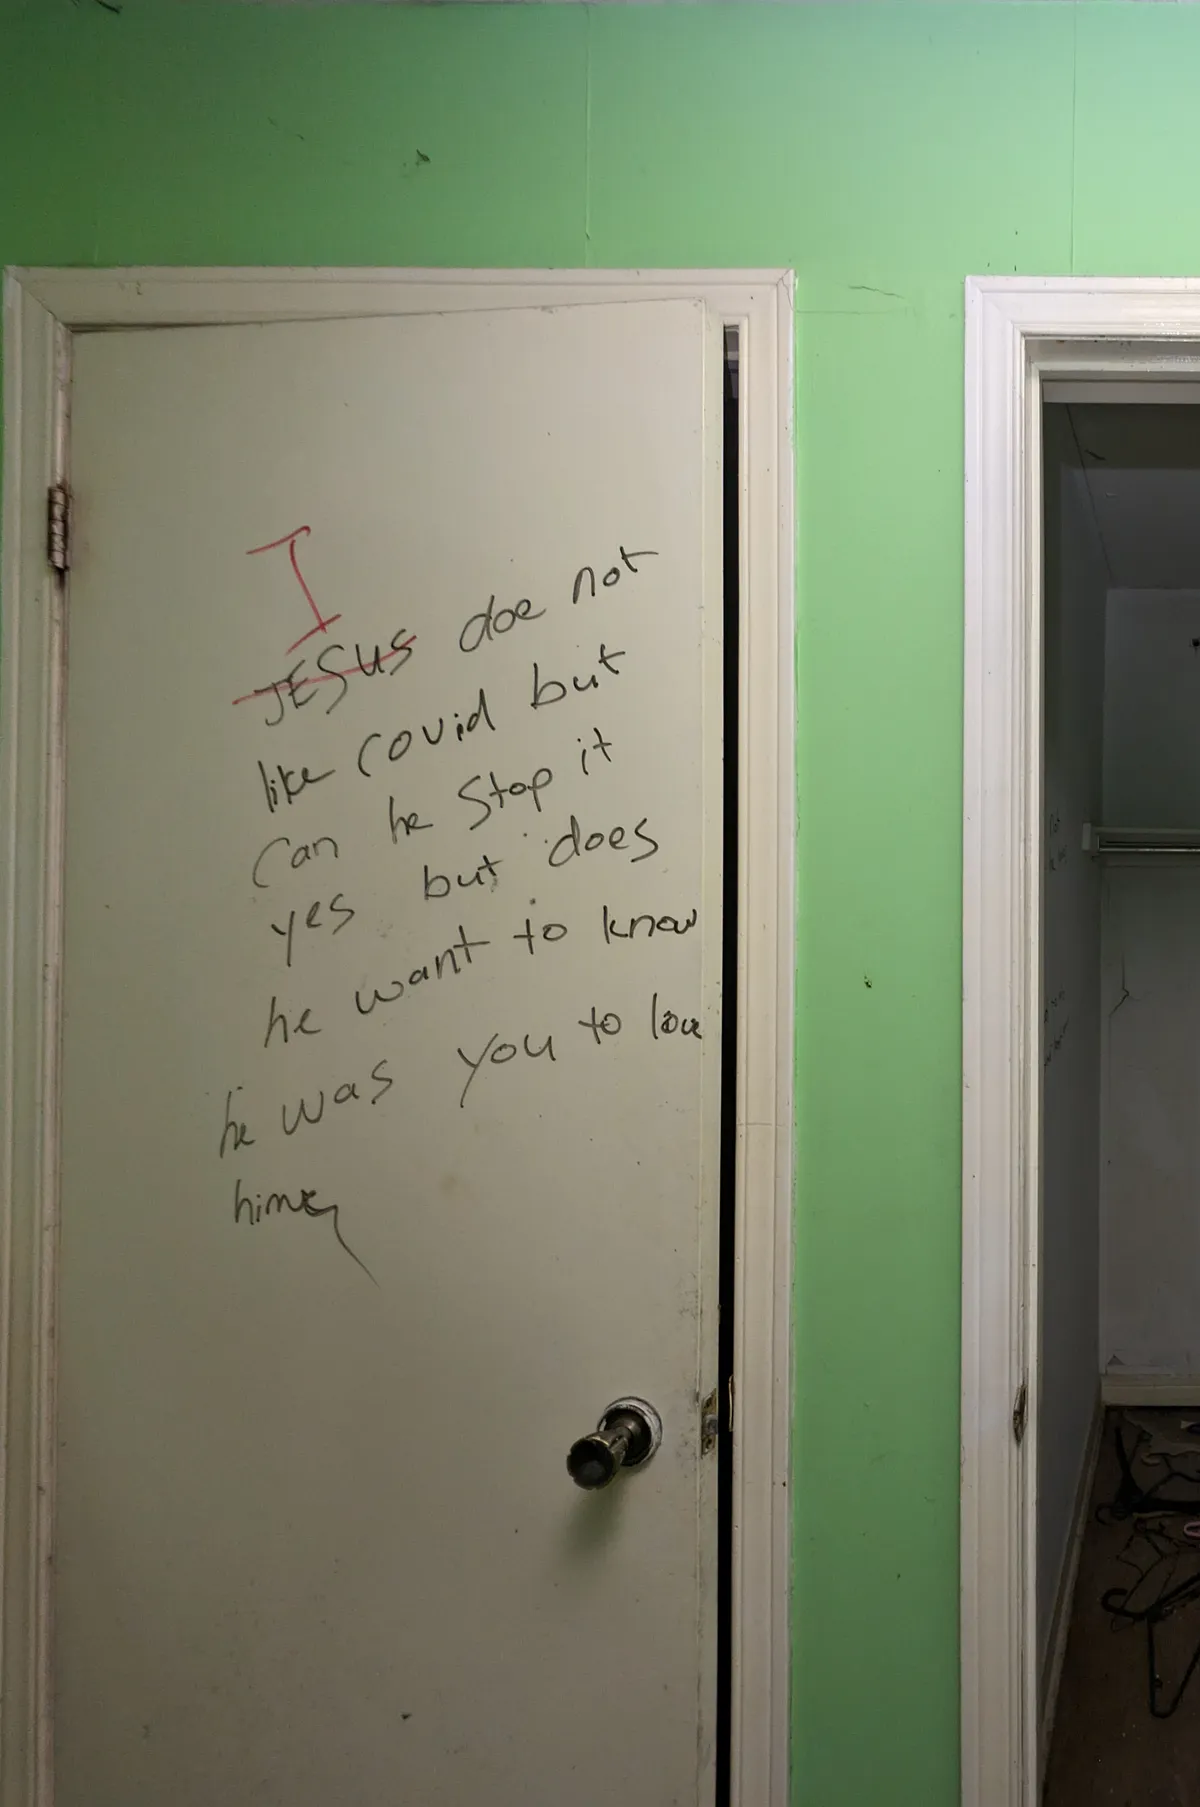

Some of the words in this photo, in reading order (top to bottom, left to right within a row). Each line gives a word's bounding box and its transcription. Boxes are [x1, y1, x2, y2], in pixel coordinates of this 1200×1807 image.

[252, 627, 414, 727] JESUS
[458, 593, 547, 653] doe
[571, 545, 660, 604] not
[256, 759, 336, 813] like
[529, 642, 626, 710] but
[387, 795, 434, 845] he
[576, 726, 613, 776] it
[269, 893, 356, 967] yes
[423, 854, 504, 900] but
[547, 816, 660, 869] does
[263, 995, 322, 1048] he
[355, 924, 491, 1015] want
[512, 917, 568, 955] to
[601, 904, 700, 944] know
[218, 1090, 256, 1159] he
[281, 1058, 394, 1137] was
[456, 1032, 557, 1109] you
[577, 1004, 623, 1045] to
